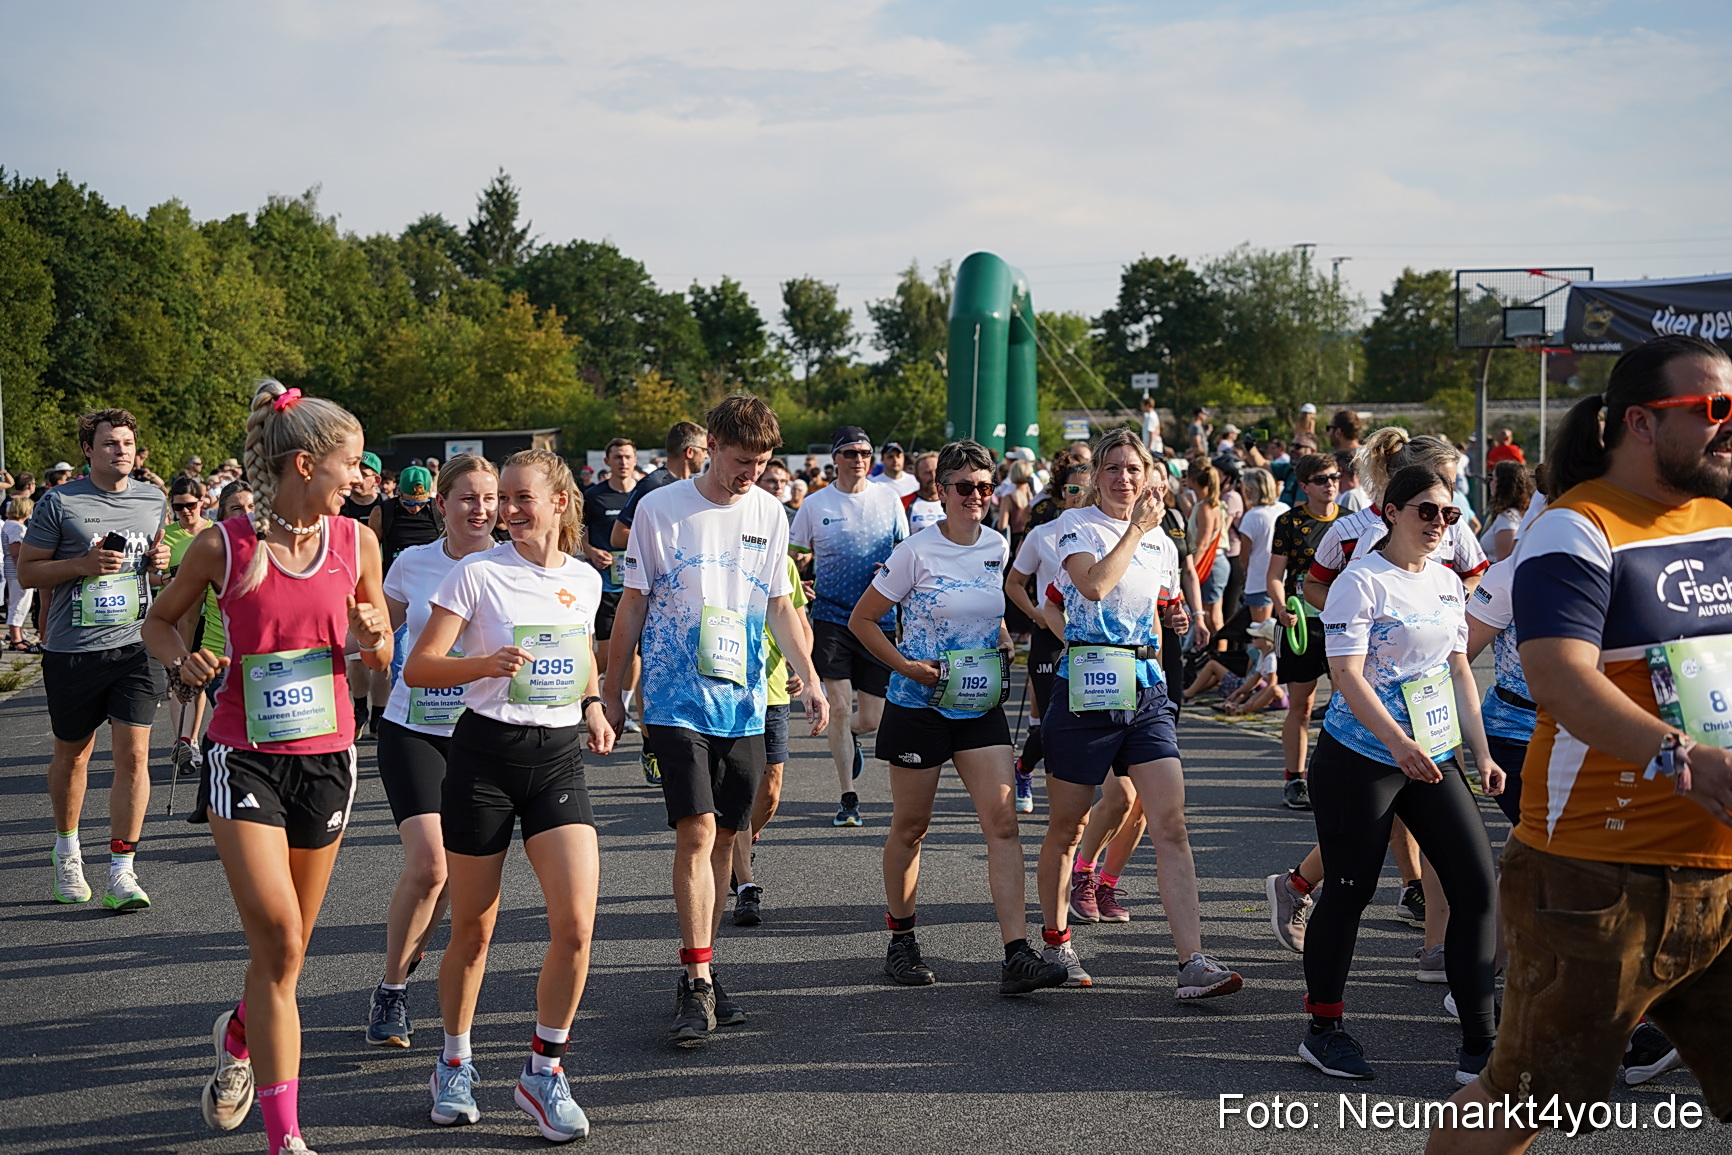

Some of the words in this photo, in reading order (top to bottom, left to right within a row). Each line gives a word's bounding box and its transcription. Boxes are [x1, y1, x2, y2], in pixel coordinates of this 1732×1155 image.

[1652, 305, 1698, 336] Hier
[1700, 311, 1732, 347] ge
[992, 423, 1006, 437] AO
[1025, 423, 1040, 437] AO
[742, 534, 767, 546] HUBER
[1140, 541, 1161, 551] HUBER
[1678, 575, 1732, 604] Fisch
[94, 595, 126, 608] 1233
[718, 636, 740, 655] 1177
[531, 658, 574, 675] 1395
[1036, 663, 1053, 674] JM
[961, 676, 988, 690] 1192
[1083, 672, 1117, 686] 1199
[263, 686, 314, 708] 1399
[440, 699, 465, 707] Inzenh
[1709, 690, 1728, 713] 8
[257, 711, 291, 721] Laureen
[292, 706, 326, 717] Enderlein
[1425, 705, 1449, 726] 1173
